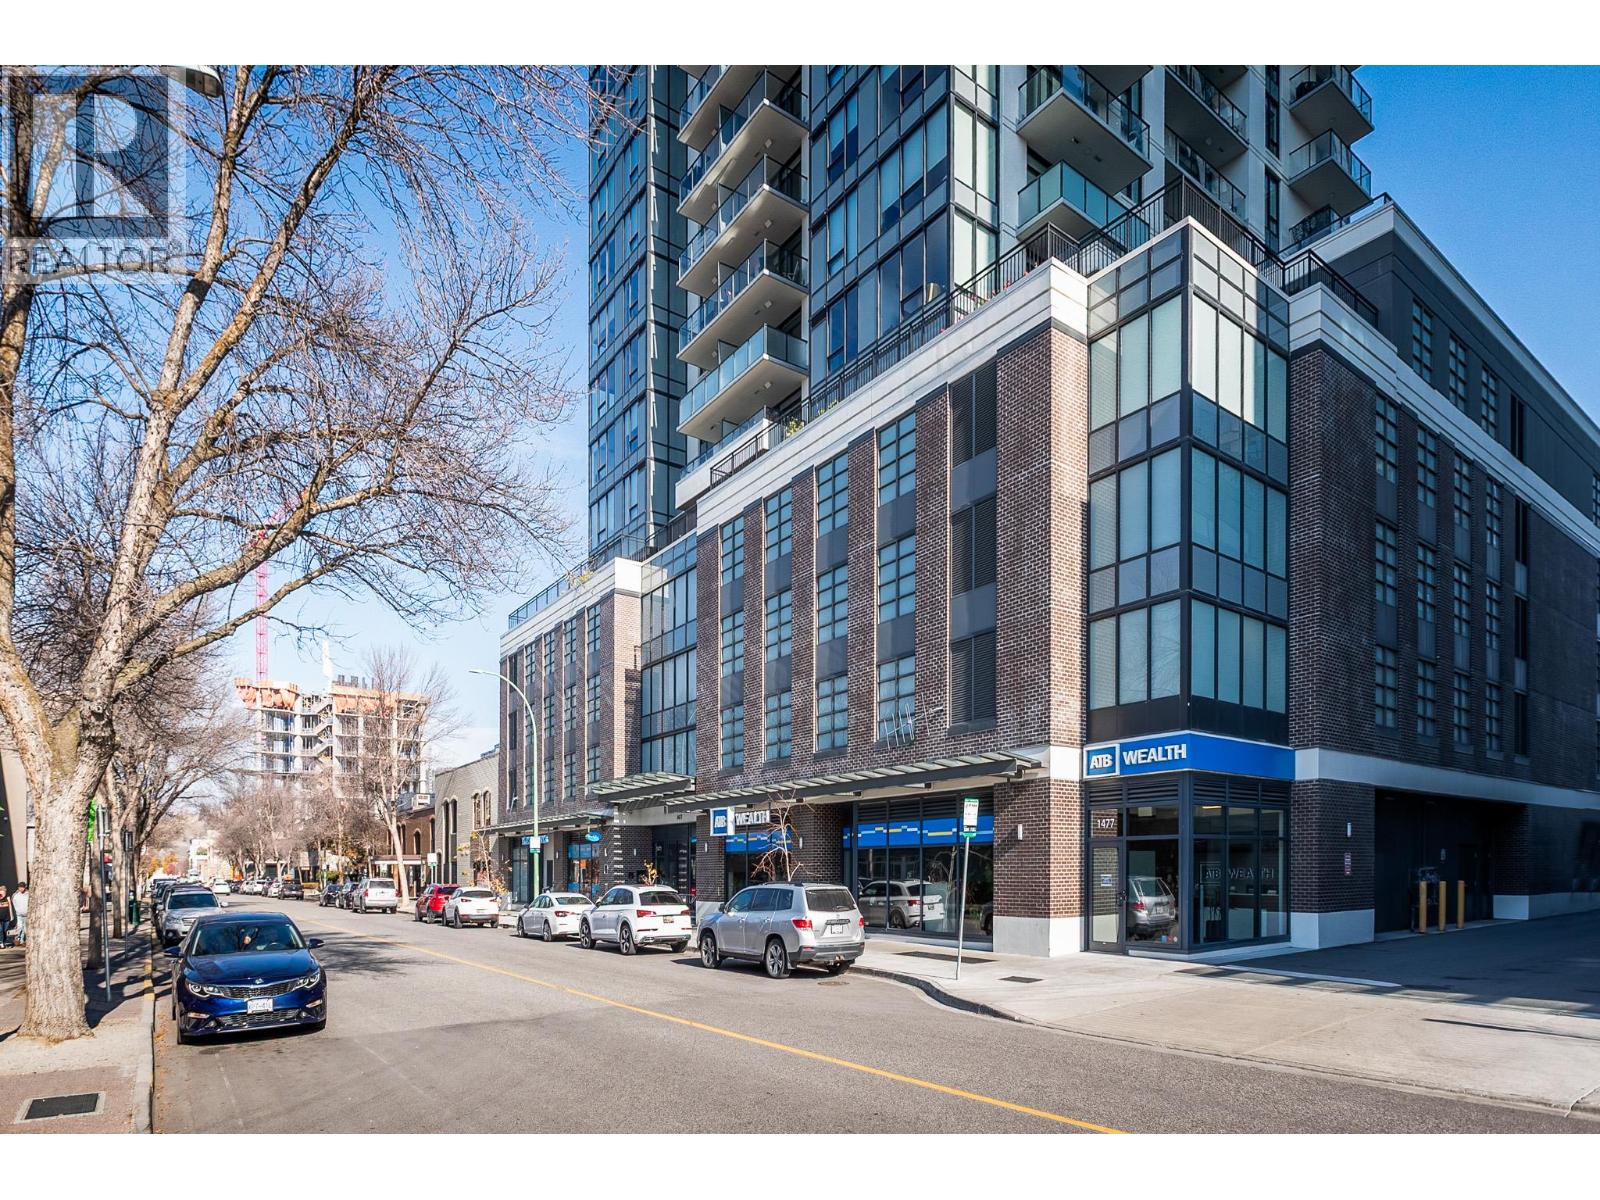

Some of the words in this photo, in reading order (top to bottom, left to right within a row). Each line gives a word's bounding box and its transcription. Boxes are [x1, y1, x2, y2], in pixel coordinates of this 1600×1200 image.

[1090, 754, 1112, 769] ATB
[1122, 743, 1187, 766] WEALTH
[735, 810, 770, 826] WEALTH
[1097, 818, 1115, 829] 1477
